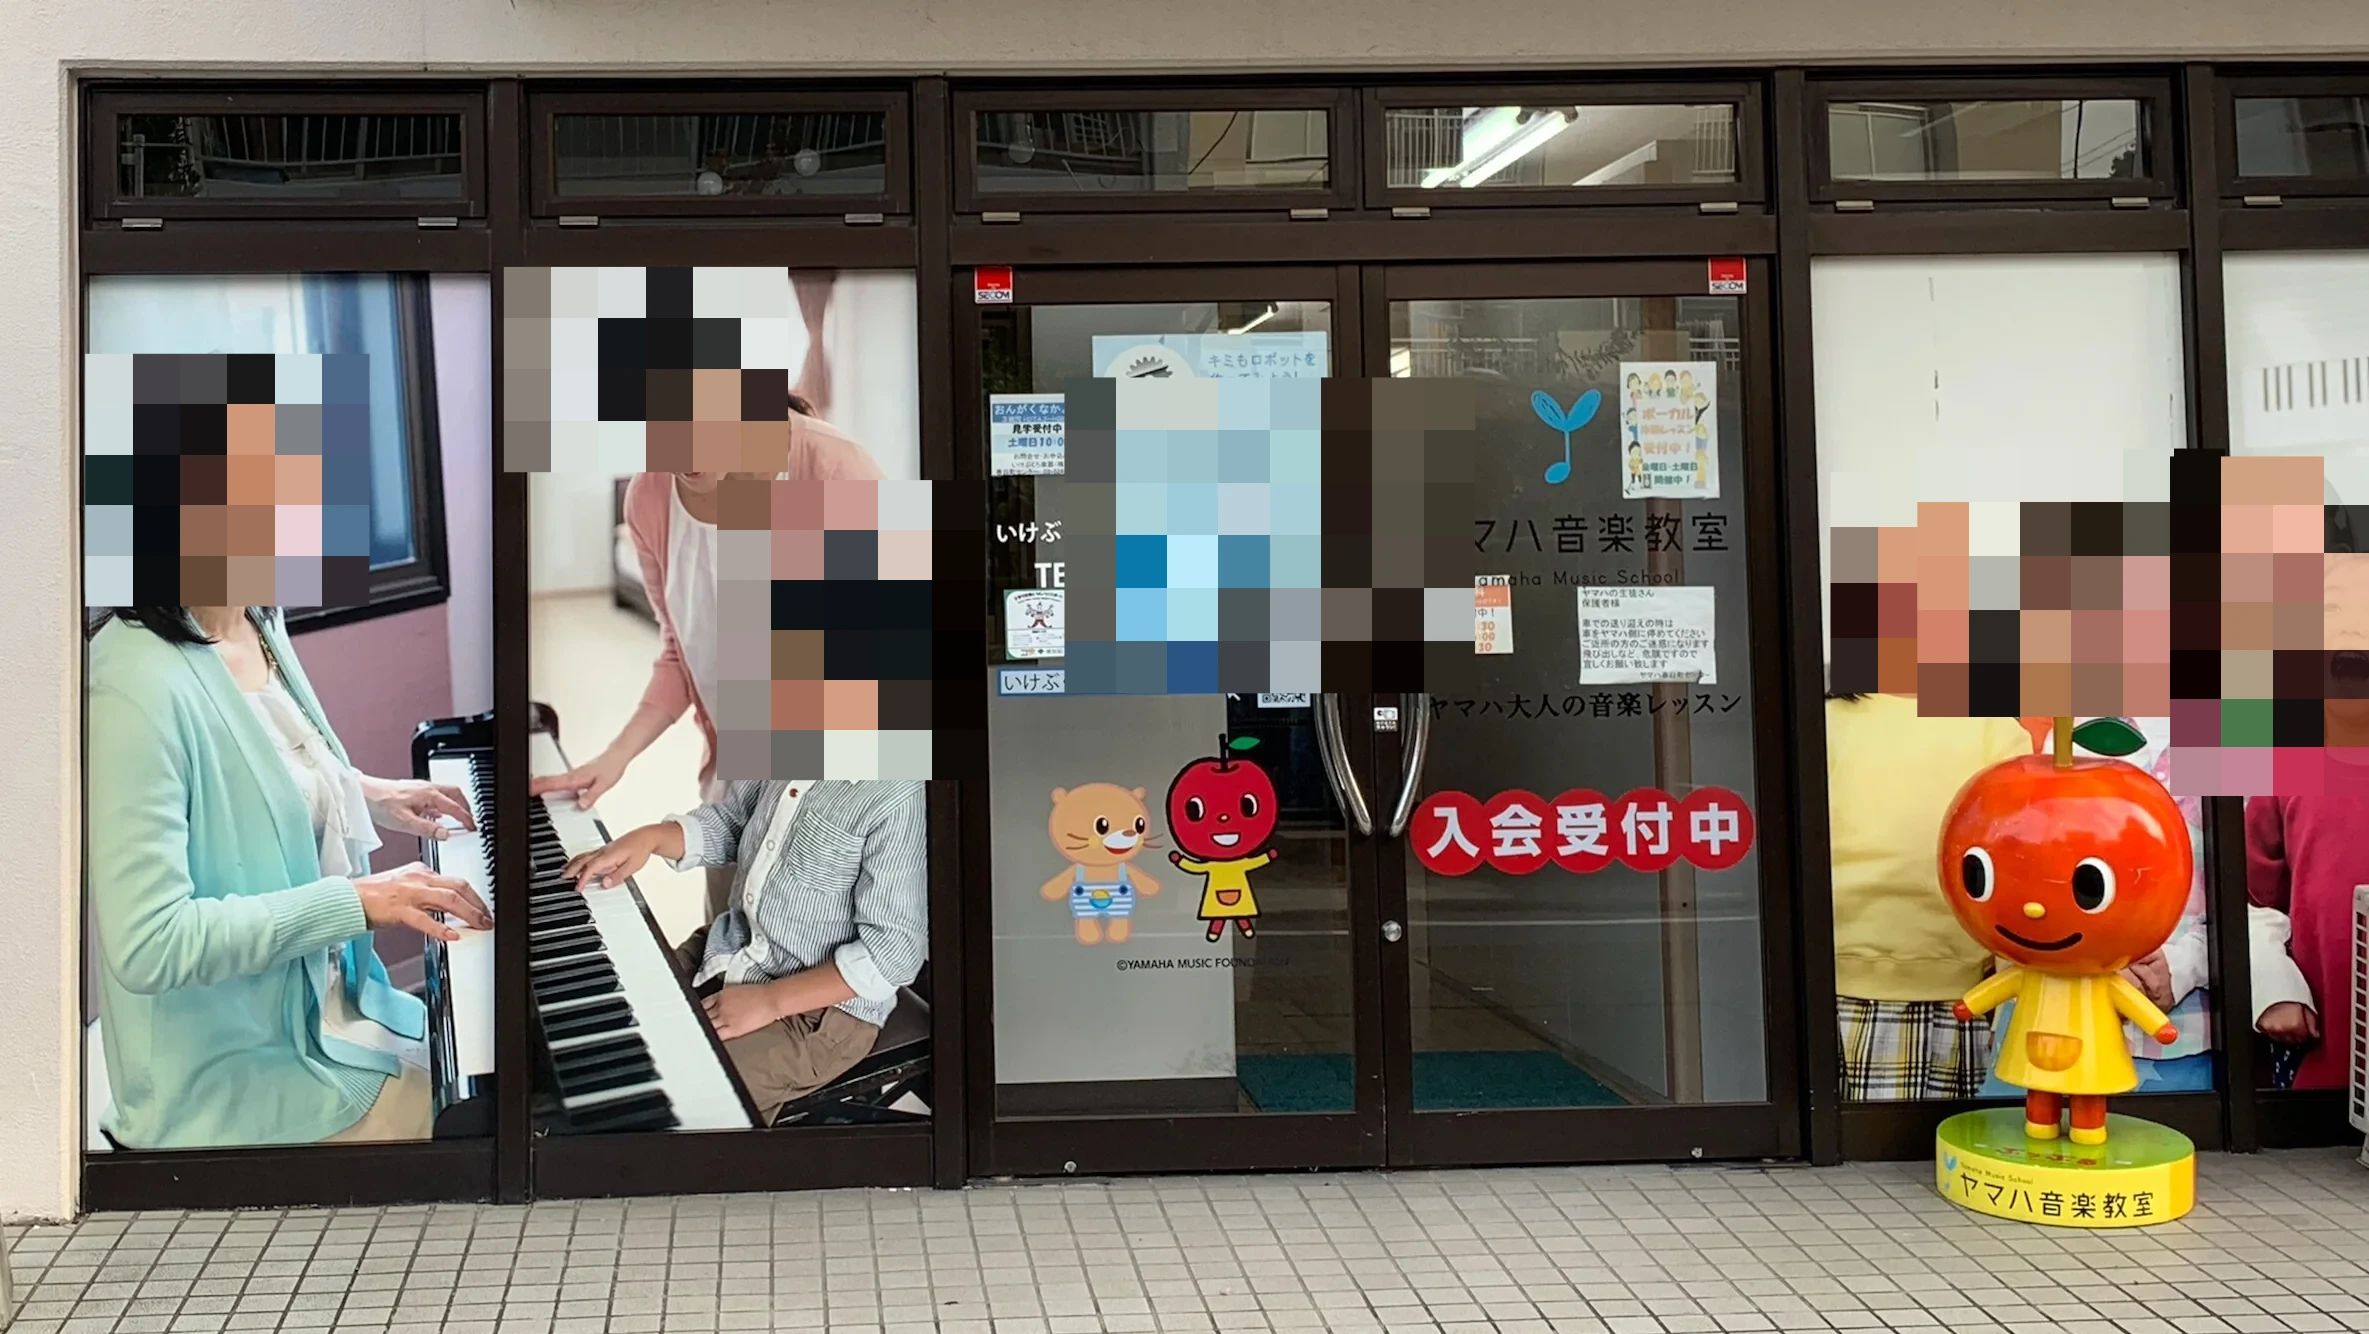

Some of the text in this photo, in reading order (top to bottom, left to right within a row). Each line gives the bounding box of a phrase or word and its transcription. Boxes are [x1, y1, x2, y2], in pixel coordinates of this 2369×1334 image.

[978, 291, 1010, 300] SECOM
[1209, 352, 1315, 367] キミもロボットを
[994, 404, 1064, 415] おんがくなか
[1643, 407, 1694, 420] ボーカル
[1013, 424, 1062, 434] 見学受付中
[1553, 571, 1607, 585] Music
[1617, 569, 1680, 585] School
[1582, 589, 1655, 598] ヤマハの生徒さん
[1582, 600, 1620, 608] 保護者様
[1582, 619, 1673, 628] 車での送り迎えの時は
[1582, 629, 1706, 639] 車をヤマハ側に停めてください
[1582, 639, 1709, 649] ご近所の方のご迷惑になります
[1583, 649, 1698, 659] 飛び出しなど、危険ですので
[1584, 660, 1668, 669] 宜しくお願い致します
[1004, 673, 1065, 691] いけぶ
[1430, 693, 1742, 720] ヤマハ大人の音楽レッスン
[1427, 801, 1740, 859] 入会受付中
[1177, 959, 1213, 969] MUSIC
[1215, 957, 1290, 968] FOUND
[1960, 1173, 2153, 1219] ヤマハ音楽教室
